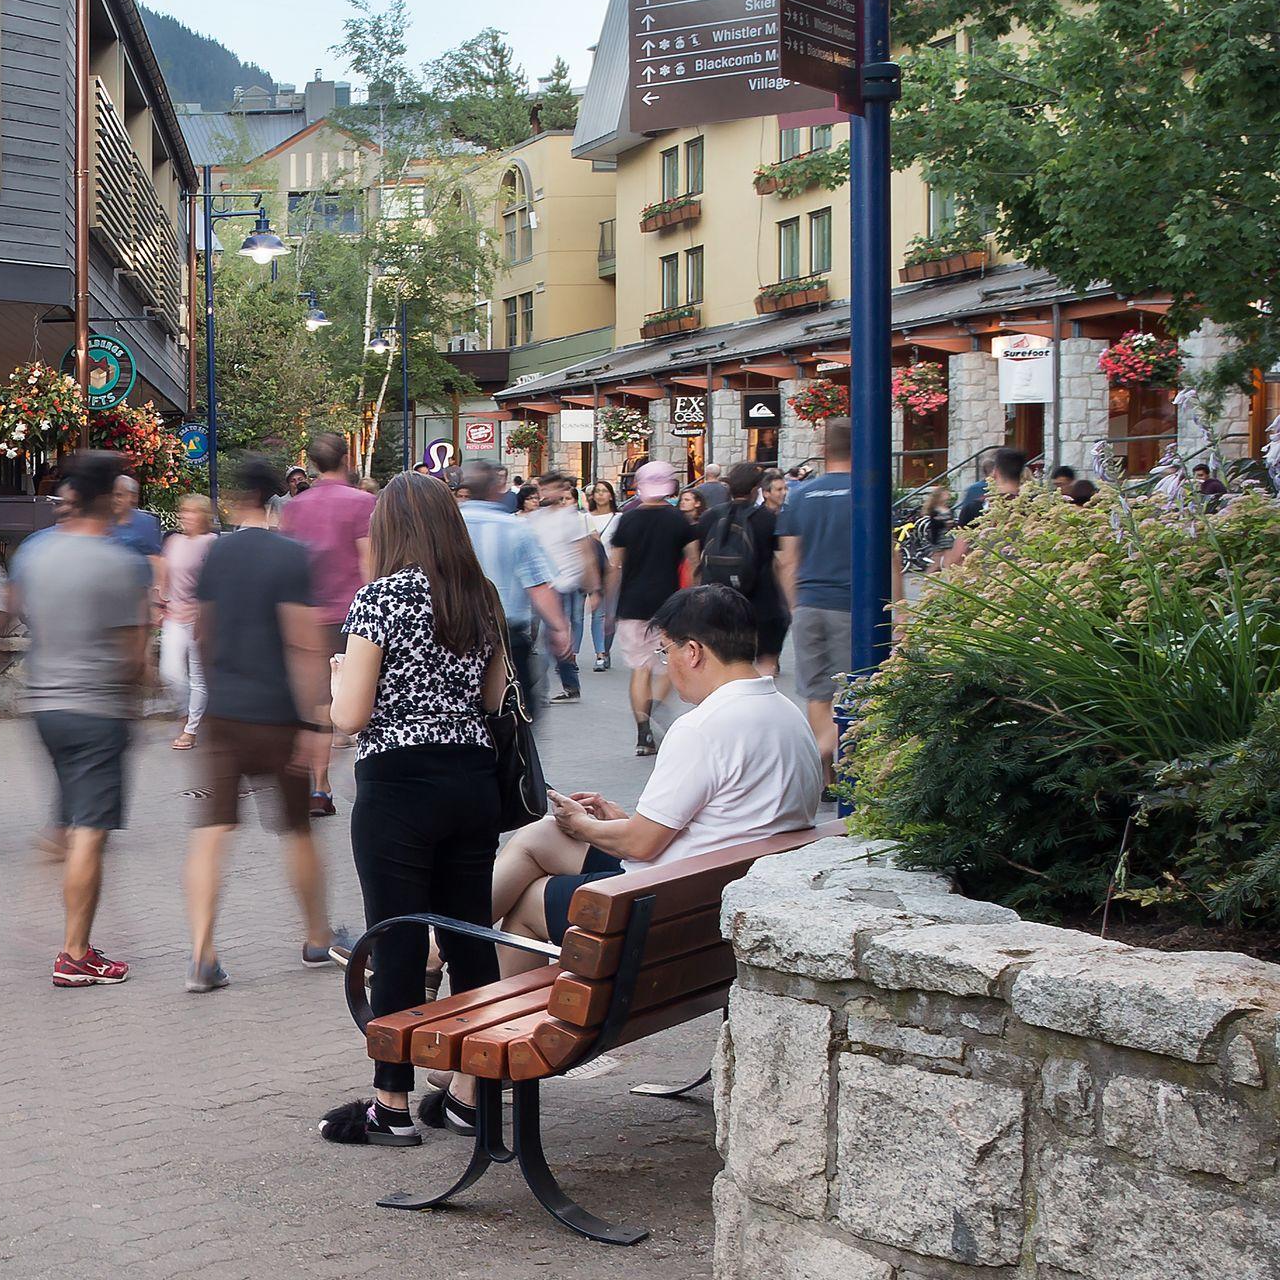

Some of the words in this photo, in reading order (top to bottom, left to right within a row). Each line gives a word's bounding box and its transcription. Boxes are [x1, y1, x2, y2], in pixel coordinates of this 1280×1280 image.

[712, 26, 763, 42] Whistler
[695, 51, 762, 72] Blackcomb
[749, 77, 791, 91] Village
[1003, 349, 1051, 358] Surefoot
